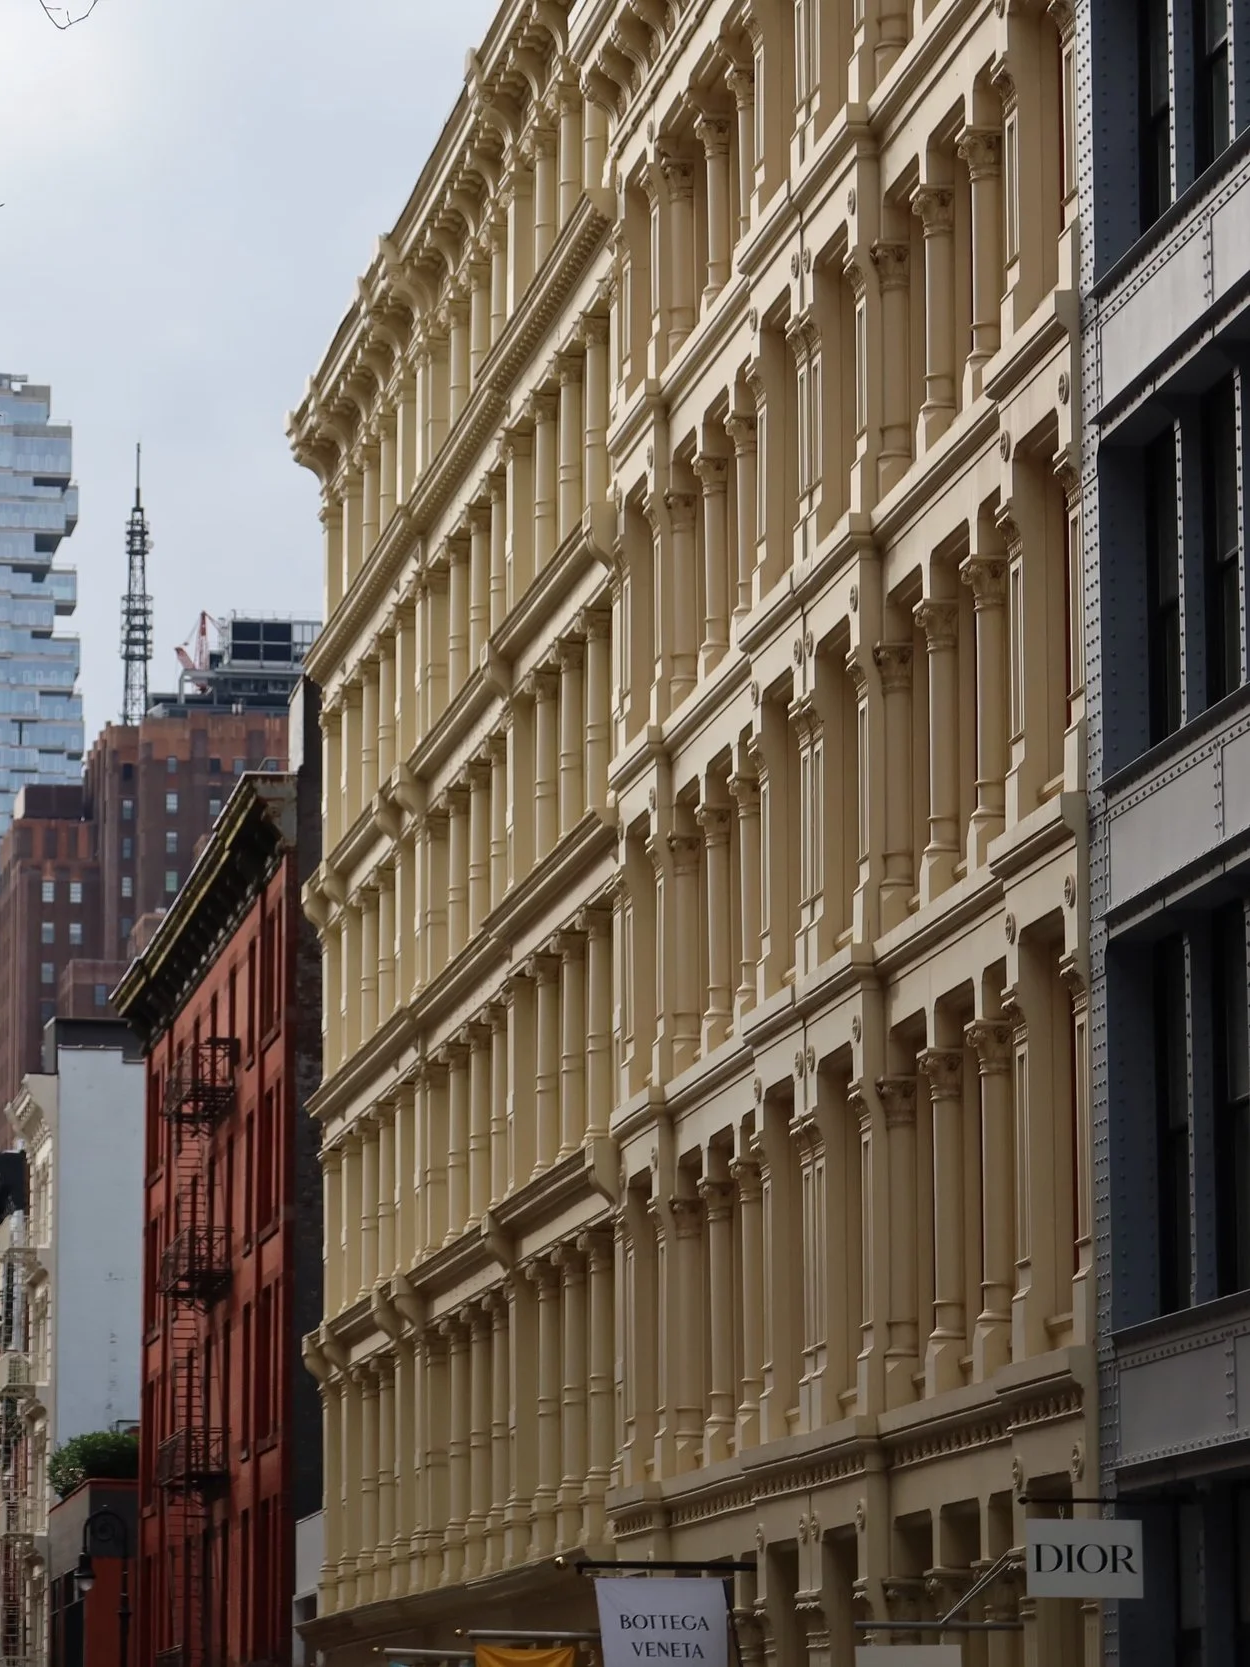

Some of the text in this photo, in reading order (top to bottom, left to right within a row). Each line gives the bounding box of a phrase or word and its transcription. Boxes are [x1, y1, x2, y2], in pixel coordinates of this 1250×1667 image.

[1032, 1543, 1137, 1574] DIOR
[620, 1613, 710, 1631] BOTTEGA
[631, 1641, 705, 1659] VENETA
